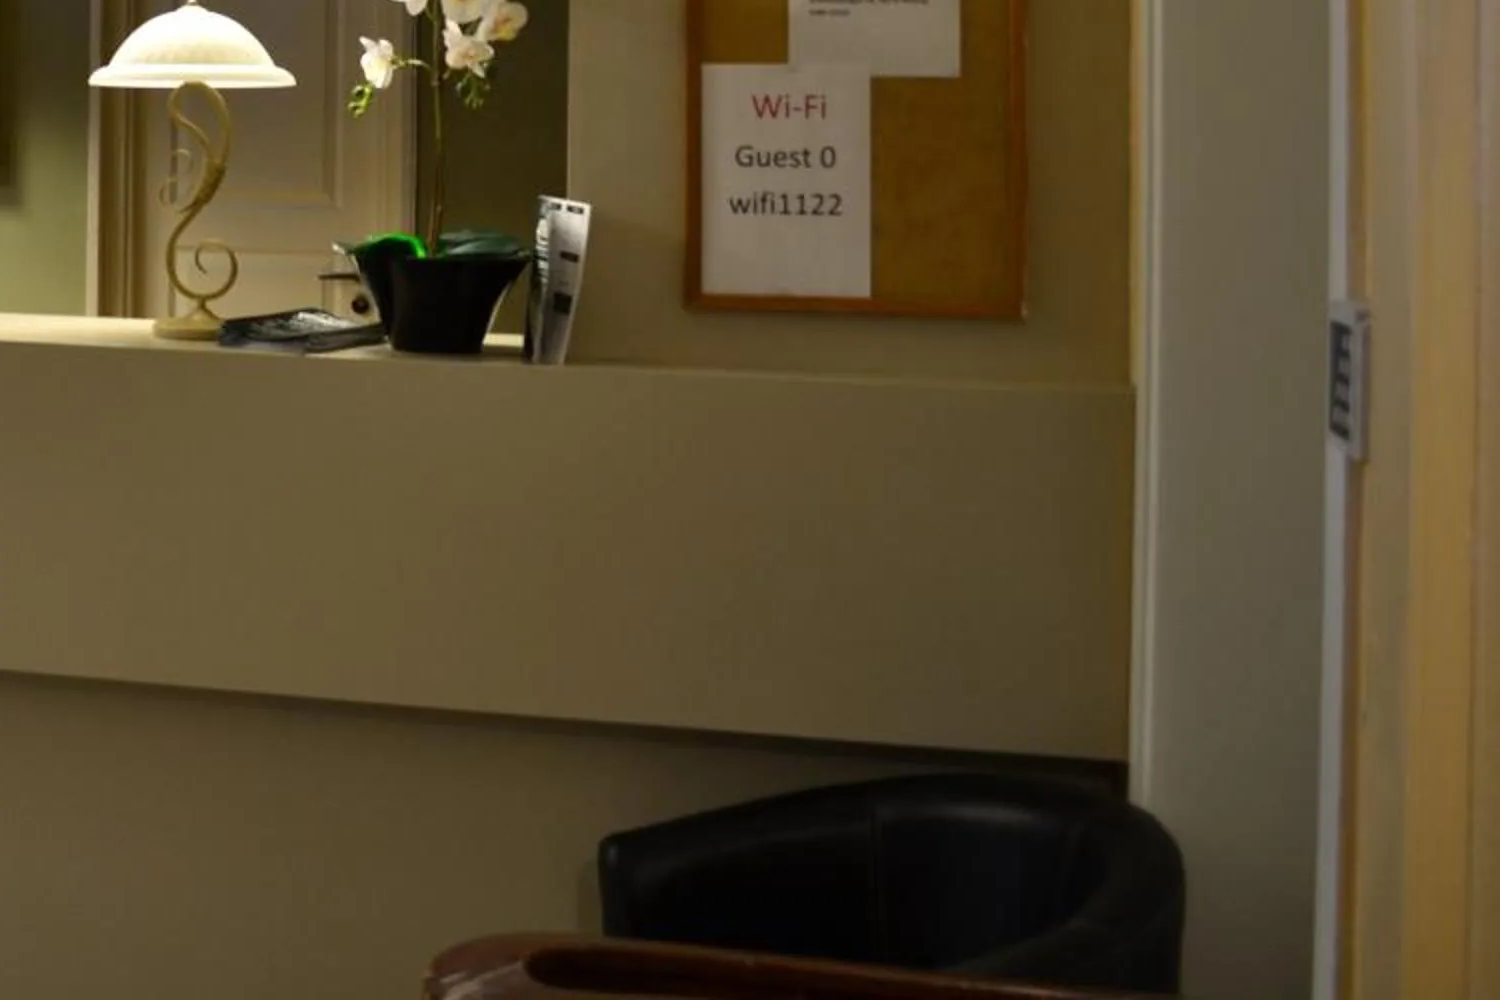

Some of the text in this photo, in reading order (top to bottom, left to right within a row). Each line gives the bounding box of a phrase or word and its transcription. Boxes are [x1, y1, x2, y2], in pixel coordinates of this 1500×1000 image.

[751, 93, 827, 119] Wi-Fi
[735, 144, 812, 169] Guest
[729, 191, 843, 216] wifi1122
